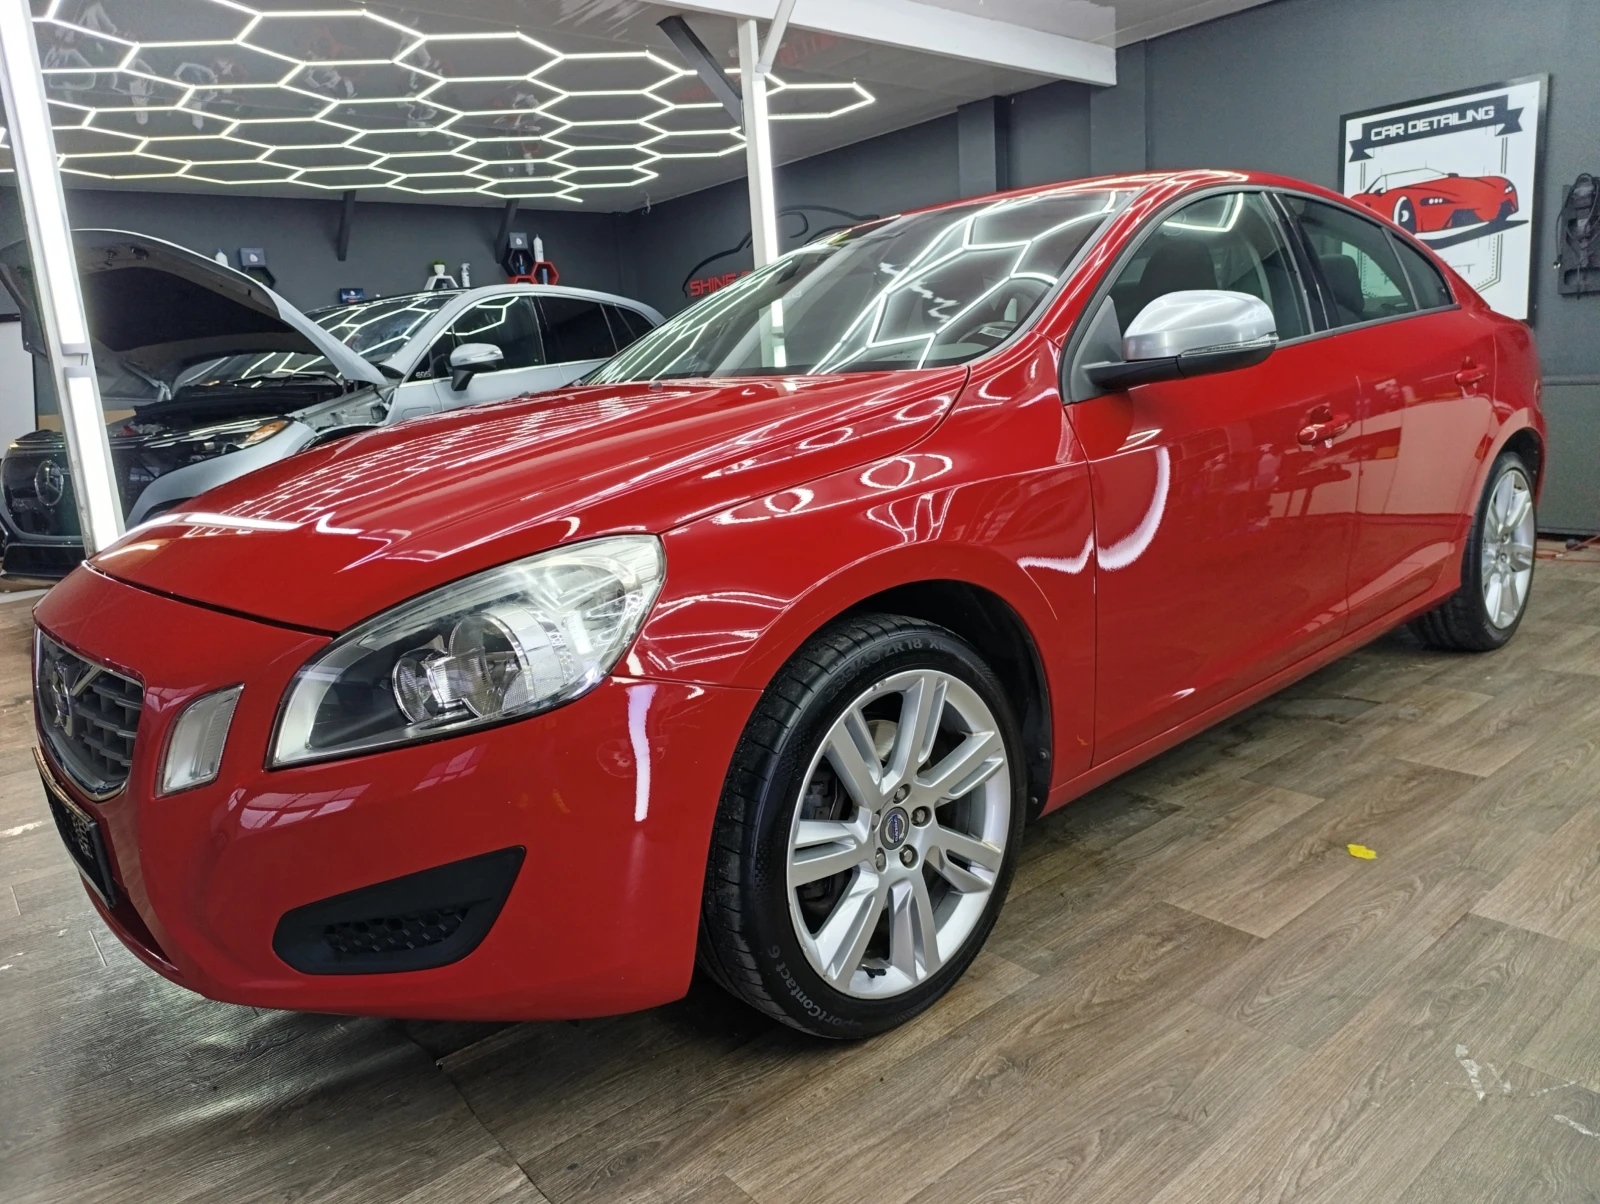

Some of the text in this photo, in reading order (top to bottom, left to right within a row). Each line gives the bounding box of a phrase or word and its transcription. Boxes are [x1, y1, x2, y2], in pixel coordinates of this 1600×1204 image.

[1371, 105, 1495, 141] CAR DETAILING
[768, 944, 781, 959] 6
